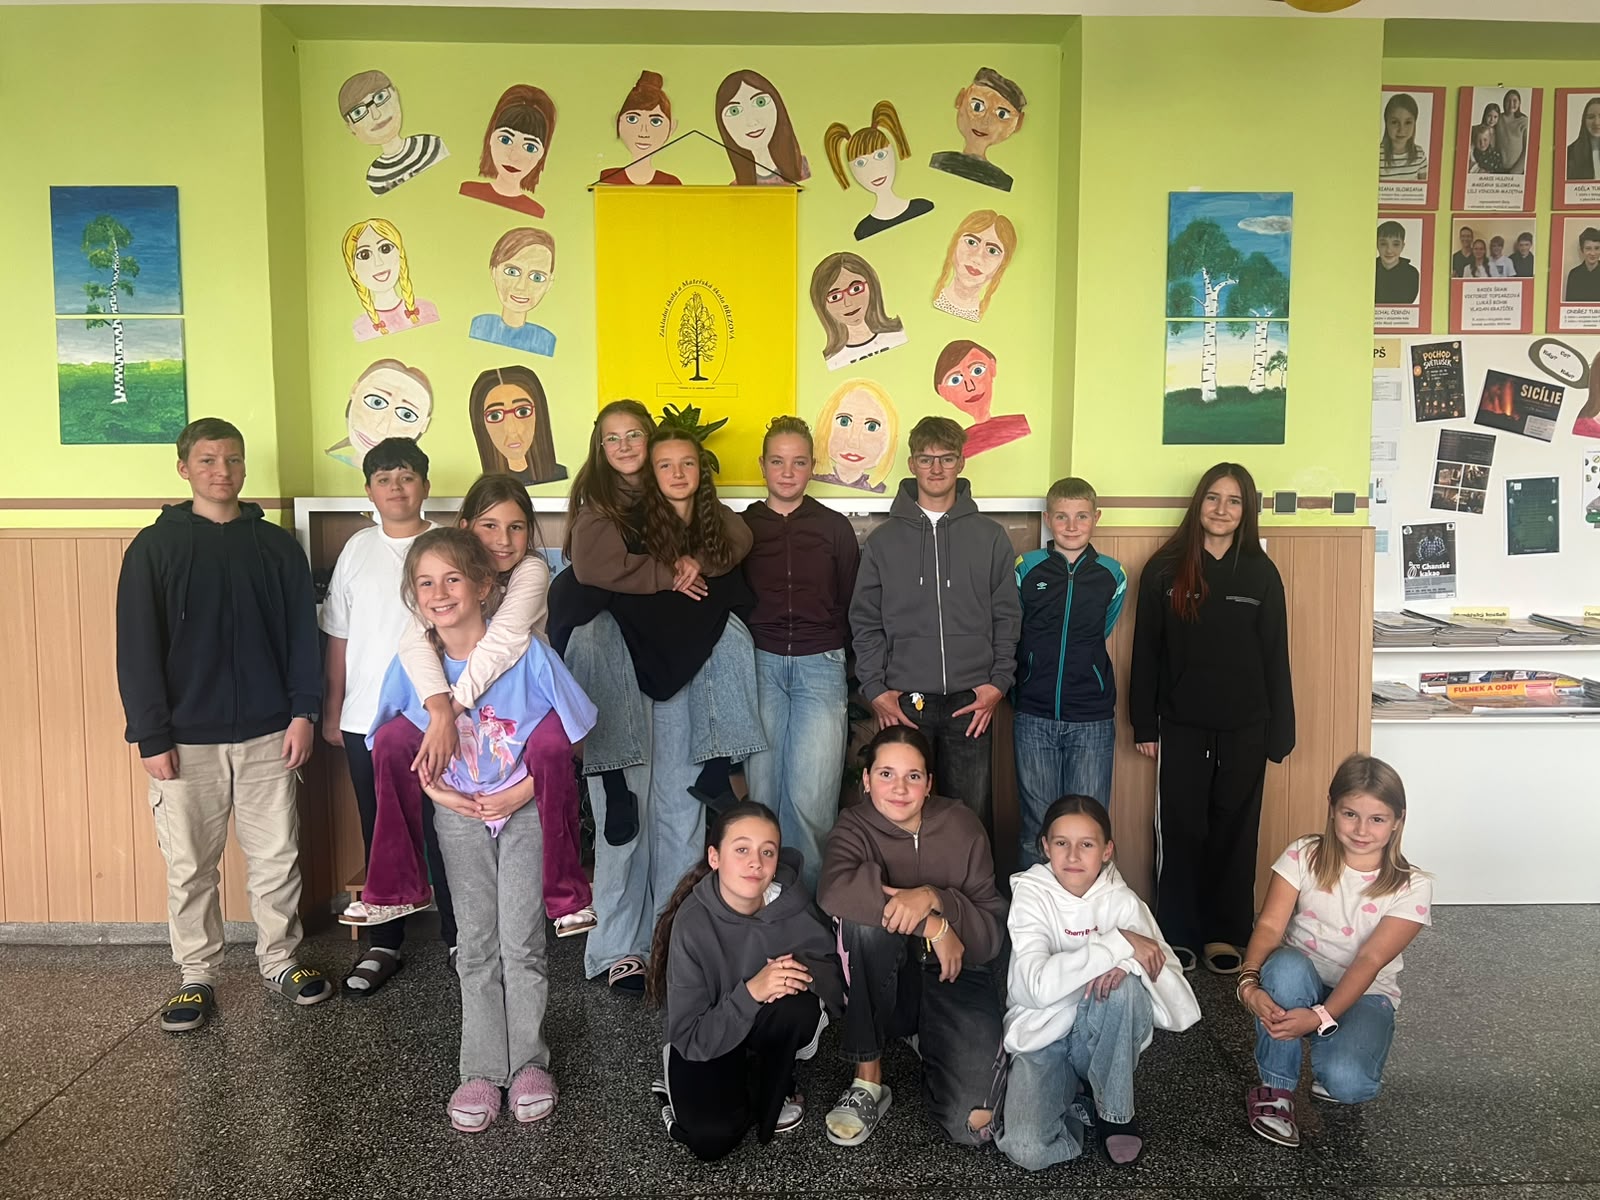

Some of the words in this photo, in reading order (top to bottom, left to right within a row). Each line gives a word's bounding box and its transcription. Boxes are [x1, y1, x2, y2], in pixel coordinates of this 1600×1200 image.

[1422, 350, 1451, 361] POCHOD
[1520, 383, 1563, 405] SICÍLIE
[1420, 569, 1441, 577] kakao
[1453, 685, 1486, 694] FULNEK
[1495, 683, 1519, 691] ODRY
[1064, 928, 1085, 937] Cherry
[291, 968, 321, 983] FILA
[167, 992, 203, 1007] FILA
